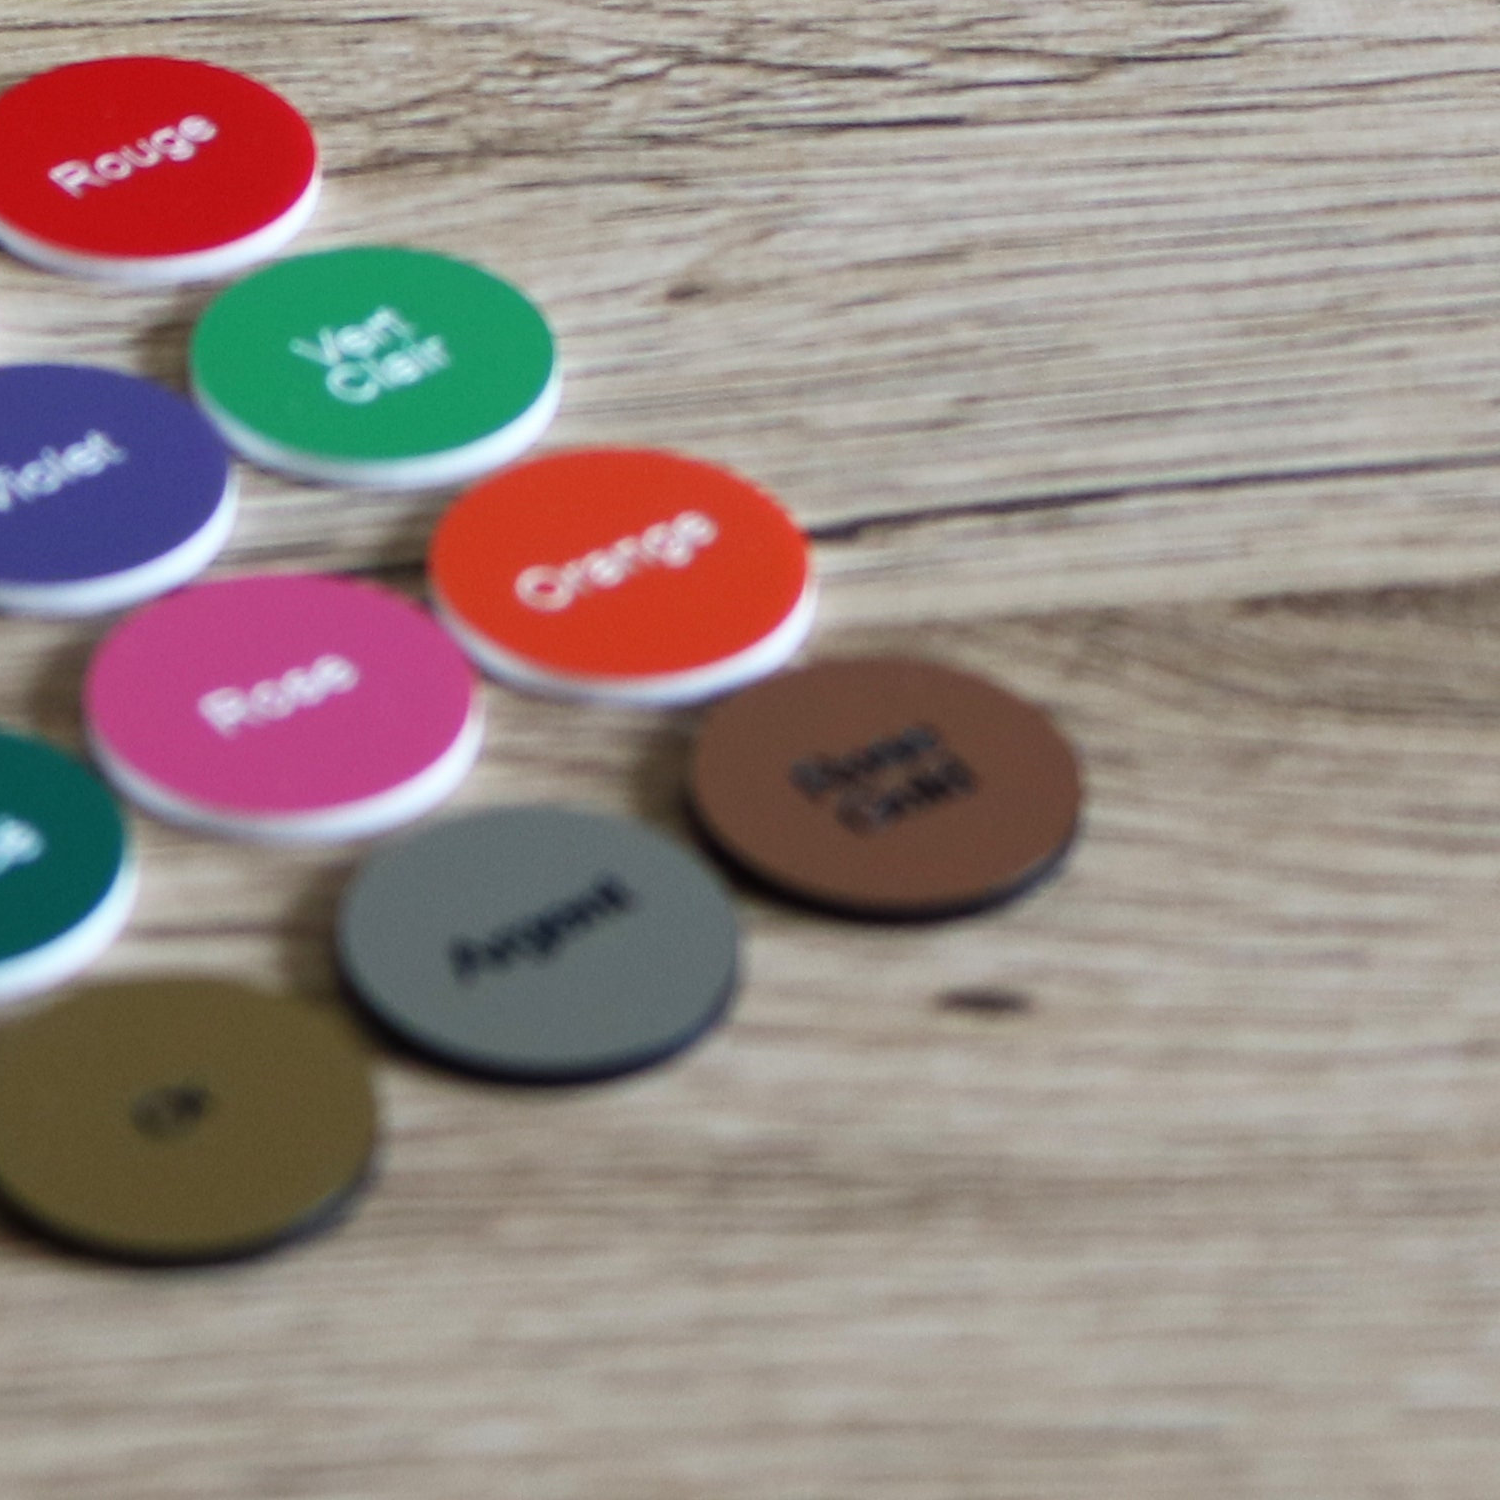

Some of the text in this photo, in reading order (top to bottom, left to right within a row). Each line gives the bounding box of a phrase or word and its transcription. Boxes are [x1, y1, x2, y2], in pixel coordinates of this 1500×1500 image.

[48, 114, 217, 198] Rouge
[290, 306, 417, 368] Vert
[514, 510, 717, 611] Orange
[197, 654, 357, 736] Rose
